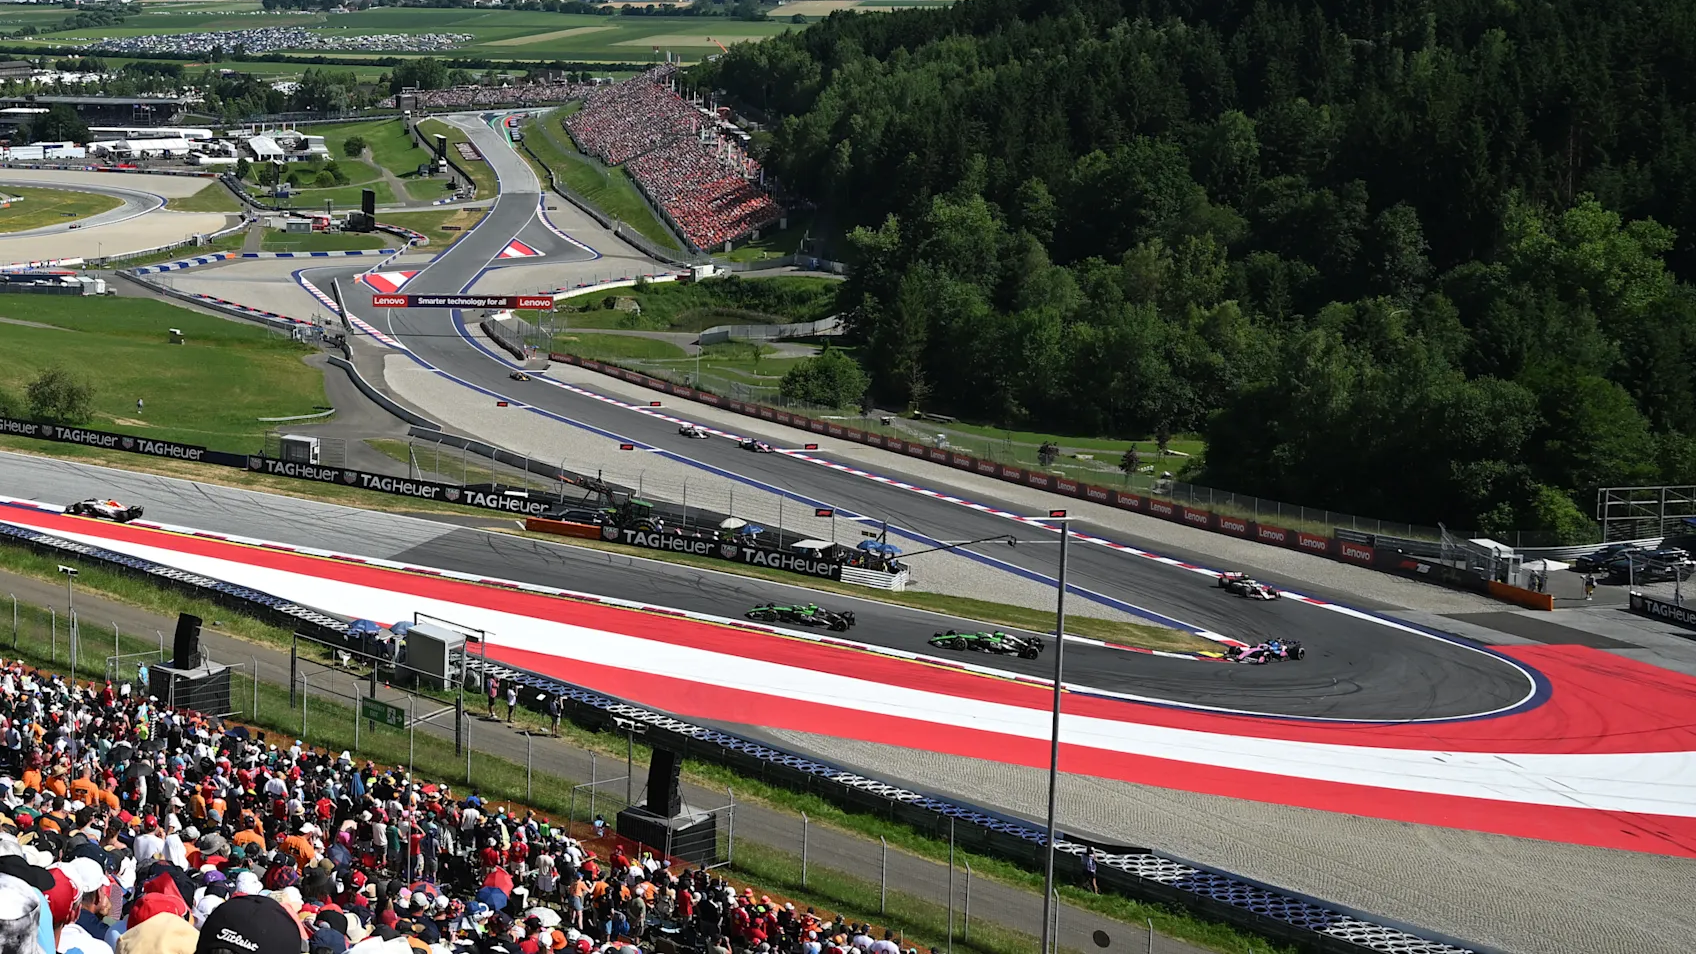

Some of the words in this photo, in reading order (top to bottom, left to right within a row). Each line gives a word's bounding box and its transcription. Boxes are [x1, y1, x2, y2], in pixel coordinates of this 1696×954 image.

[374, 297, 405, 305] Lenovo
[418, 297, 446, 305] Smarter
[447, 297, 486, 307] technology
[487, 297, 497, 305] for
[498, 297, 507, 305] all
[519, 298, 551, 307] Lenovo
[954, 454, 969, 466] Lenovo
[977, 460, 994, 473] Lenovo
[1002, 467, 1020, 479] Lenovo
[1029, 473, 1047, 486] Lenovo
[1057, 479, 1076, 492] Lenovo
[1087, 486, 1107, 500] Lenovo
[1117, 492, 1139, 507] Lenovo
[1150, 500, 1172, 515] Lenovo
[1184, 509, 1207, 524] Lenovo
[1220, 516, 1245, 533] Lenovo
[1258, 525, 1285, 542] Lenovo
[1299, 533, 1326, 551] Lenovo
[1342, 542, 1371, 561] Lenovo
[1644, 599, 1696, 625] TAGHeue
[216, 927, 259, 952] Titleist
